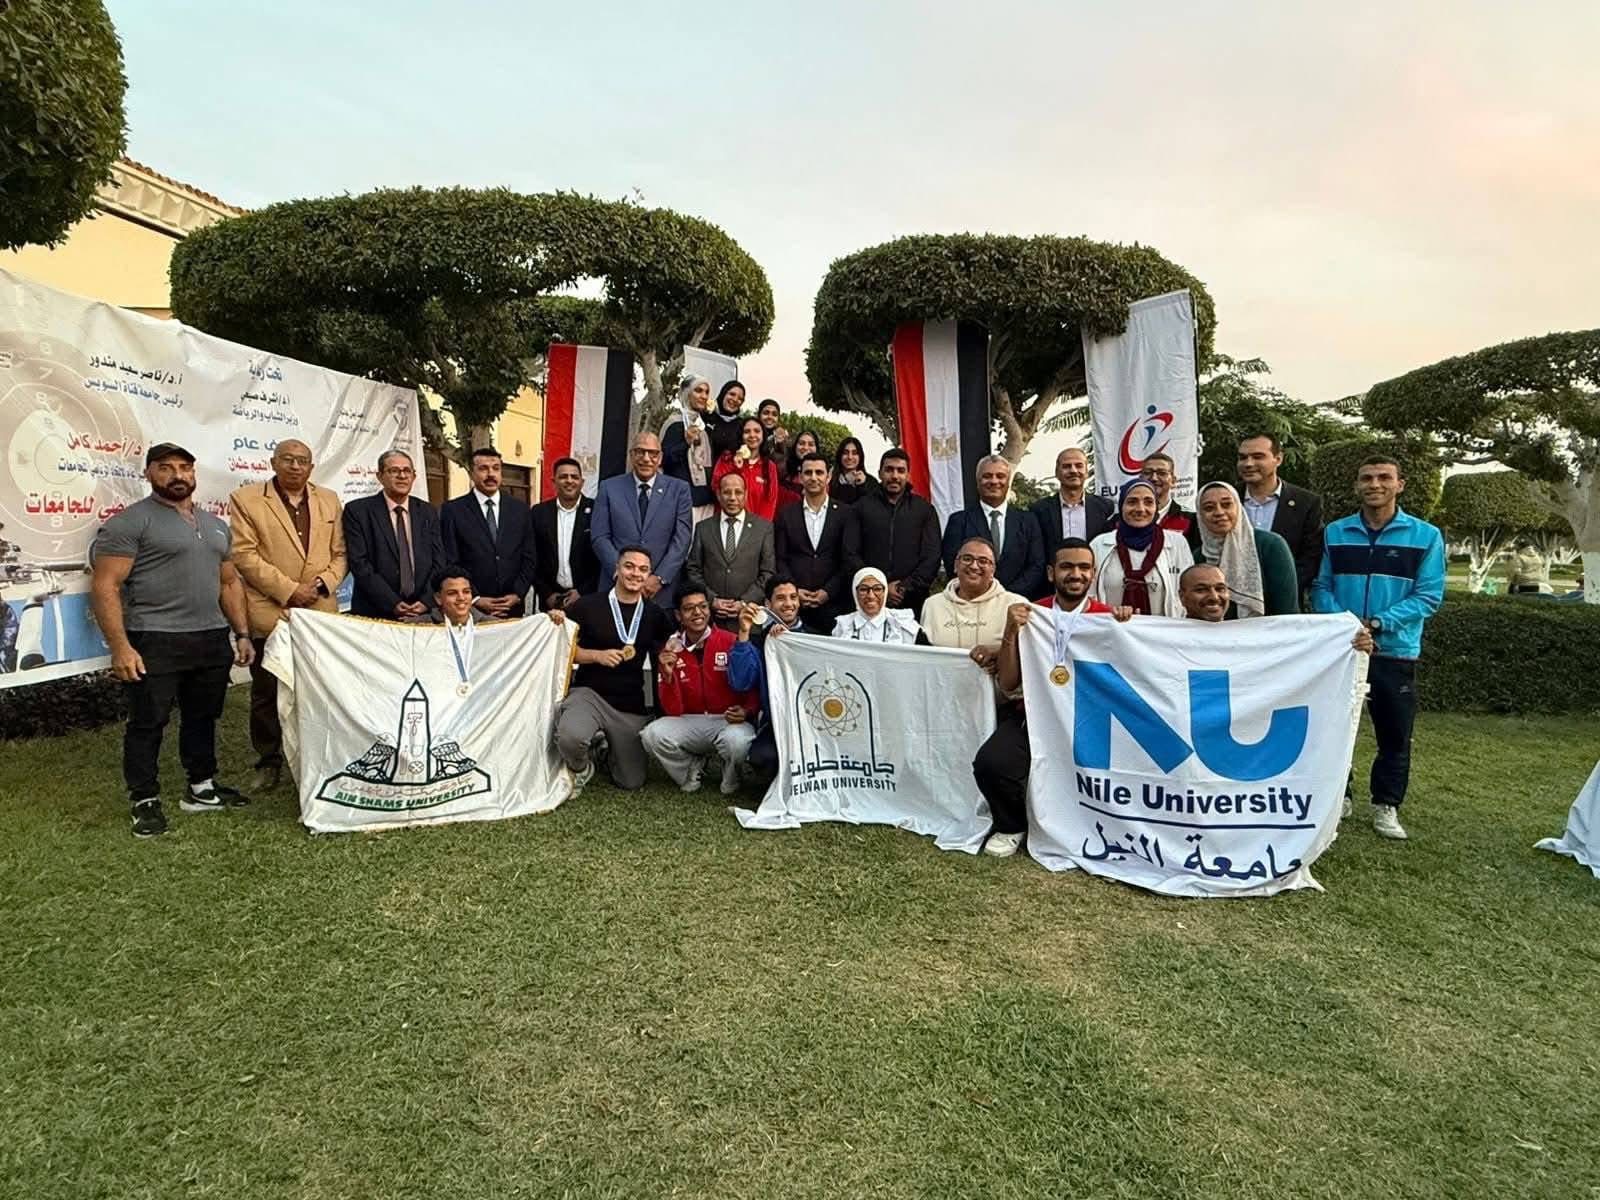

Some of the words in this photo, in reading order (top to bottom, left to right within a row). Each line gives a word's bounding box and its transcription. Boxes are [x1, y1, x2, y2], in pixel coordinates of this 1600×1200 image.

[233, 437, 260, 451] عام
[1101, 485, 1118, 497] EU
[25, 493, 95, 518] للجامعات
[1073, 659, 1309, 782] NU
[406, 783, 476, 807] UNIVERSITY
[832, 777, 897, 793] UNIVERSITY
[1076, 771, 1132, 806] Nile
[1142, 783, 1313, 822] University
[1082, 821, 1165, 868] النيل
[1184, 833, 1302, 881] جامعة
